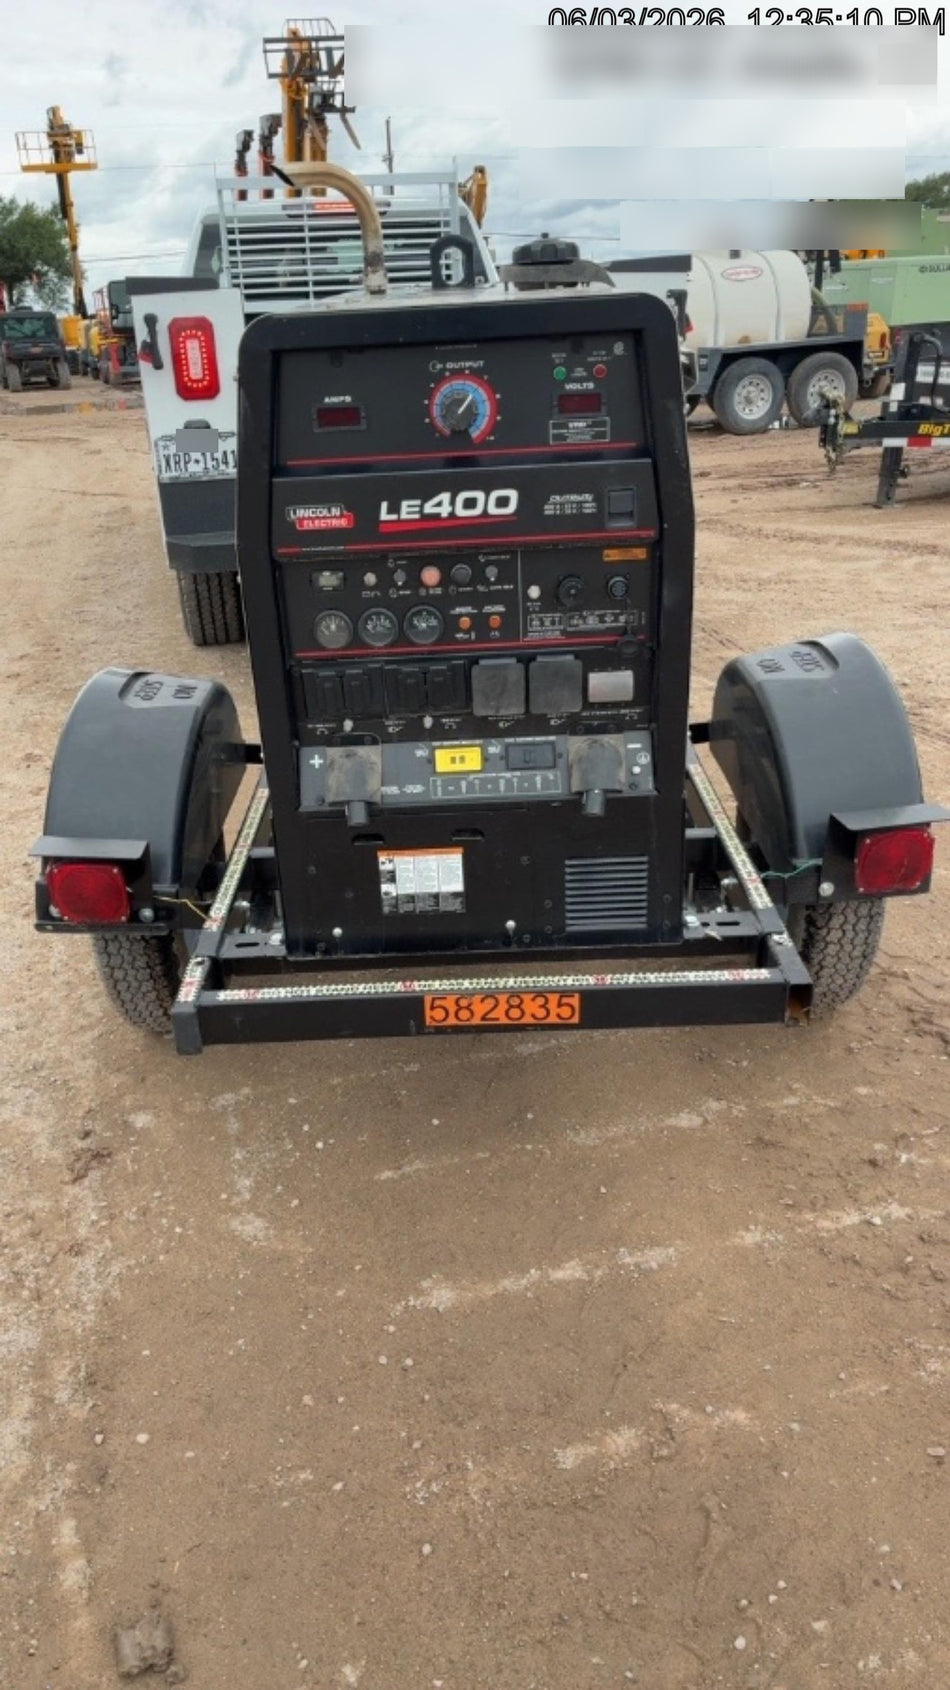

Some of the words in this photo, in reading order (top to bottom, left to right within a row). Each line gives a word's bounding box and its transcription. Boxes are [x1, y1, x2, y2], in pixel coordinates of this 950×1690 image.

[446, 361, 485, 369] OUTPUT
[564, 381, 595, 390] VOLTS
[379, 488, 519, 521] LE400
[290, 505, 341, 519] LINCOLN
[303, 517, 349, 528] ELECTRIC
[429, 994, 577, 1023] 582835
